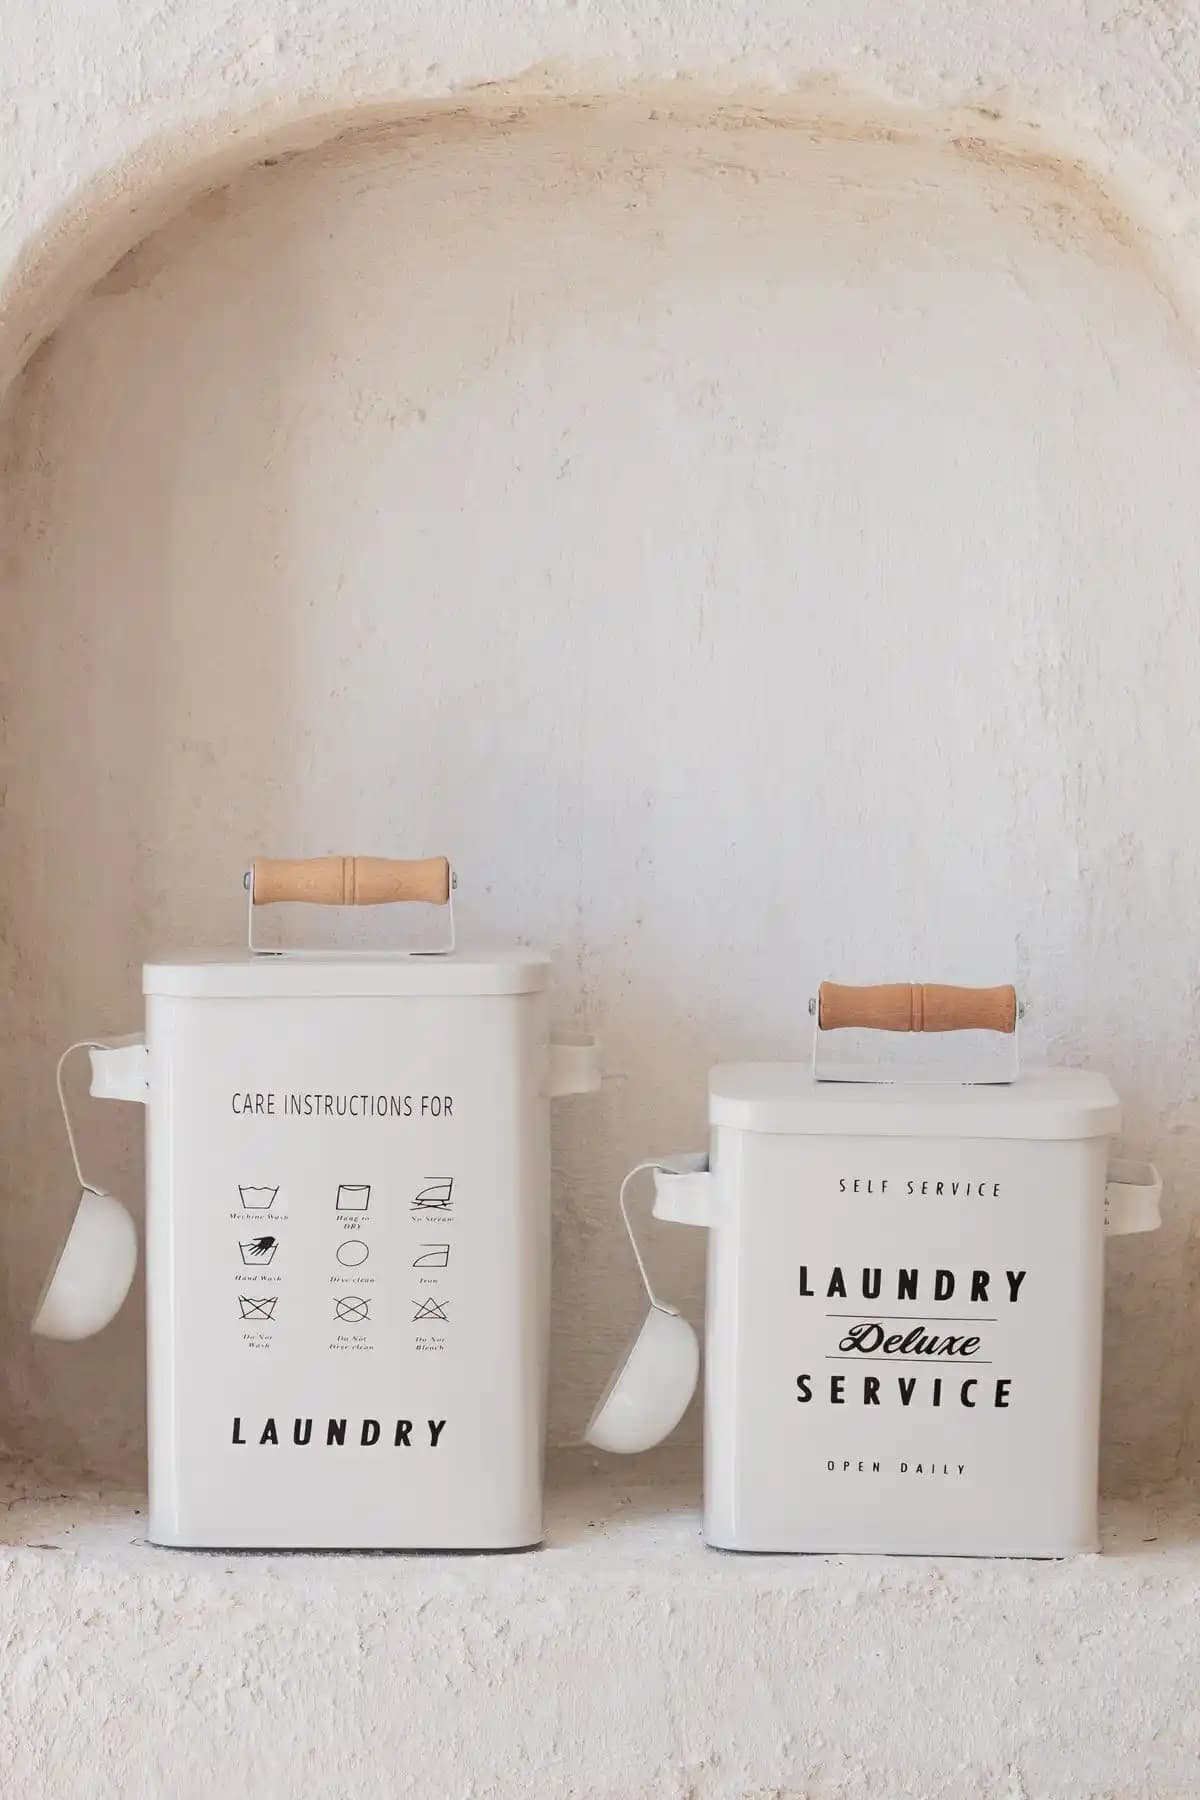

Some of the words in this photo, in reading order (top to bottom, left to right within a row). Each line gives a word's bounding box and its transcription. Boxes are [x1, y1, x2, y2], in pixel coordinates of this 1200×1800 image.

[232, 1093, 275, 1115] CARE
[284, 1093, 412, 1117] INSTRUCTIONS
[421, 1095, 453, 1117] FOR
[839, 1178, 889, 1194] SELF
[907, 1180, 1001, 1198] SERVICE
[799, 1265, 1027, 1303] LAUNDRY
[838, 1322, 981, 1356] Deluxe
[796, 1373, 1013, 1409] SERVICE
[231, 1416, 448, 1448] LAUNDRY
[827, 1460, 881, 1473] OPEN
[900, 1462, 965, 1476] DAILY
